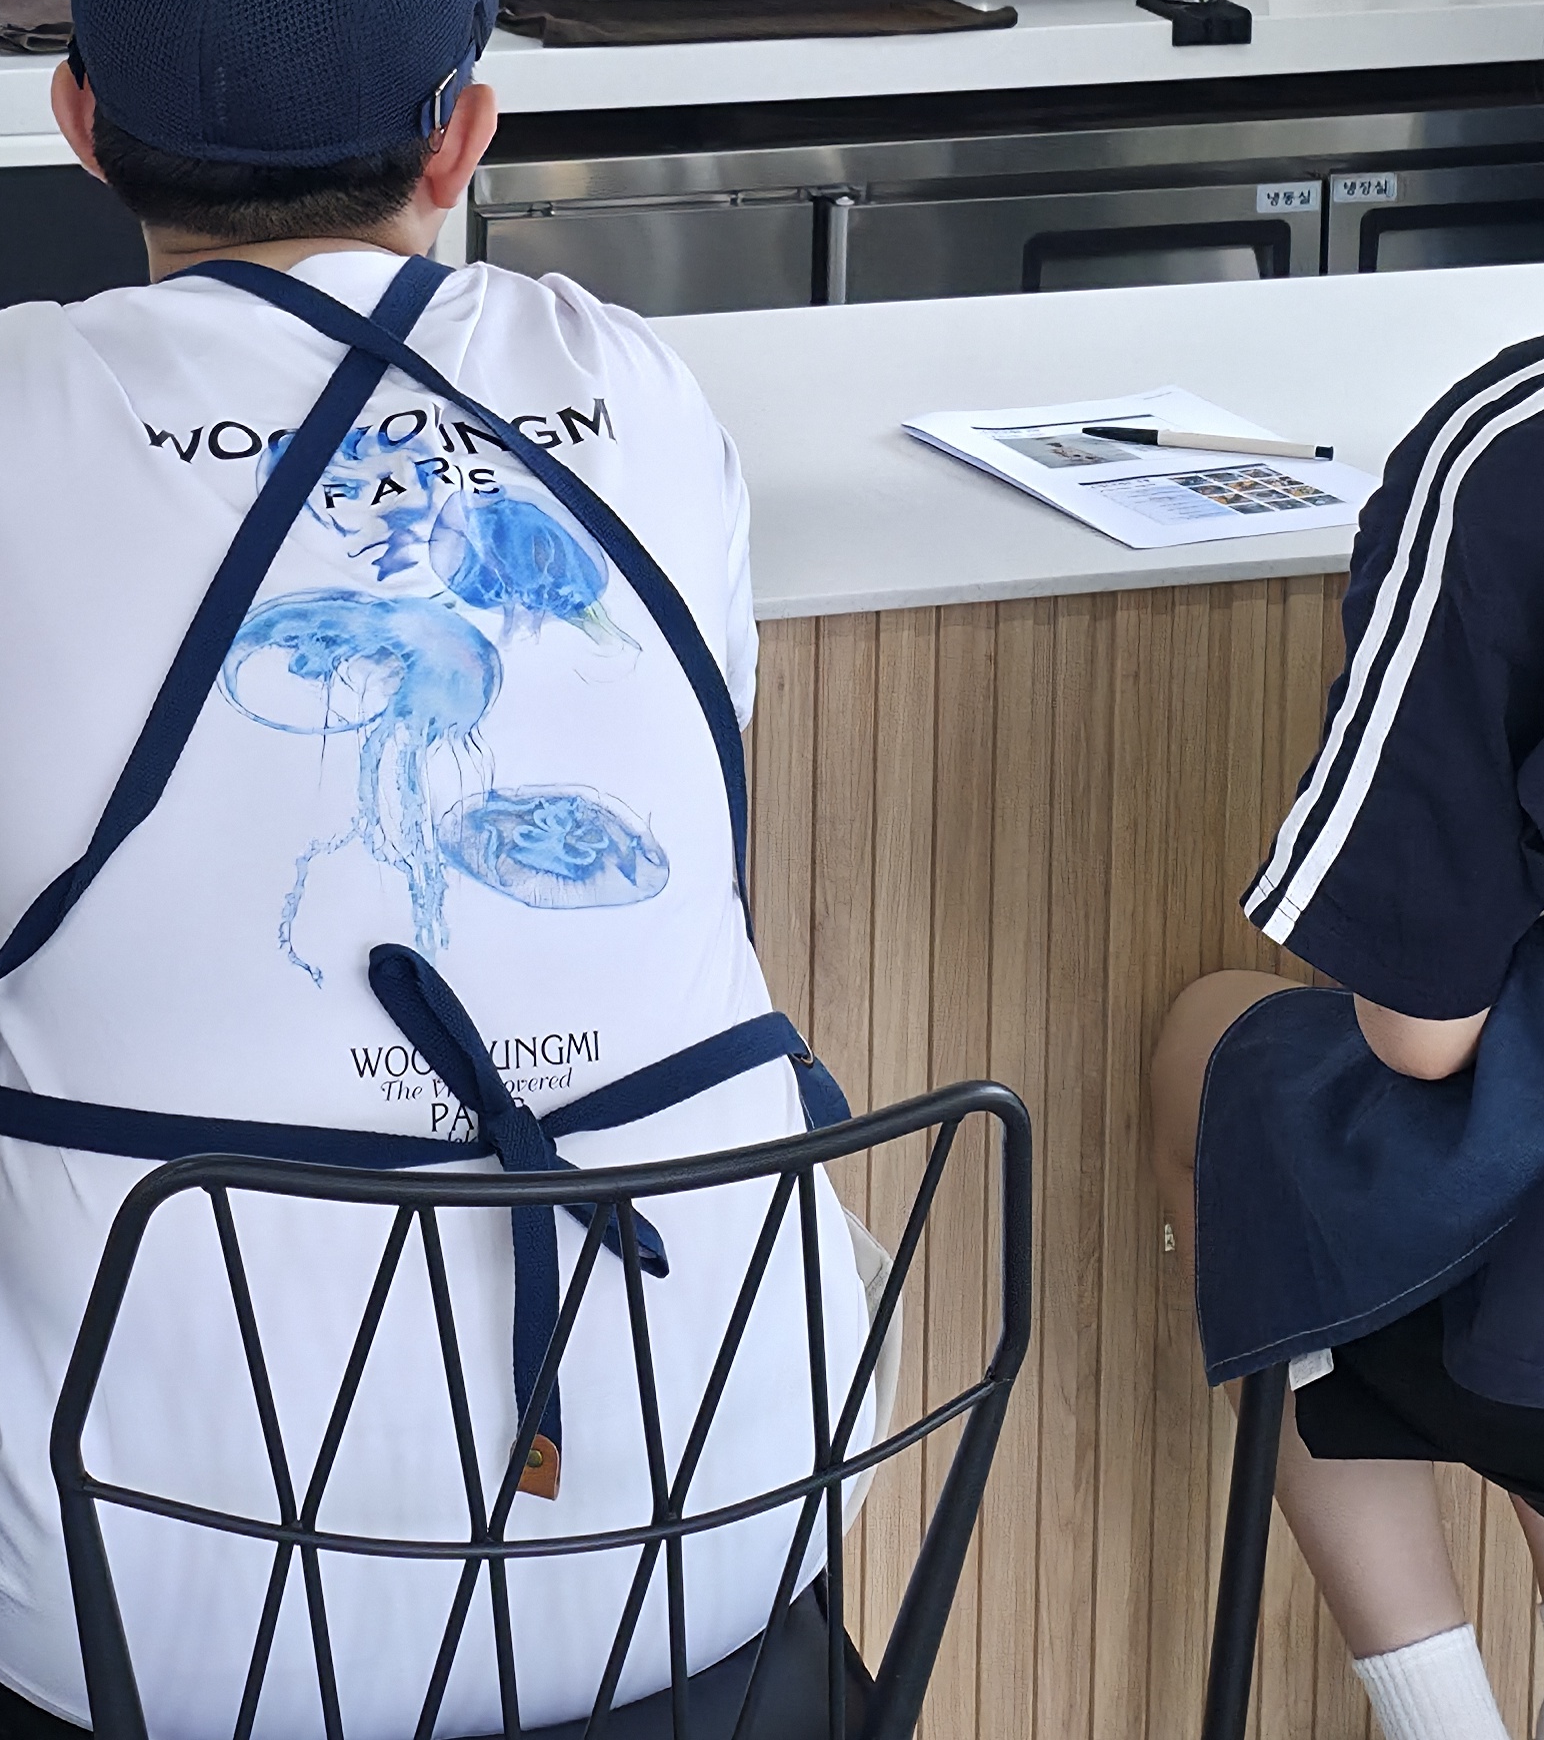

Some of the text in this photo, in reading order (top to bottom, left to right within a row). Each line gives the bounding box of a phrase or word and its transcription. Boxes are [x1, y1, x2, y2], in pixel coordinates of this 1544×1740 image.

[1343, 178, 1388, 196] 냉장실
[1266, 189, 1312, 207] 냉동실
[349, 1030, 600, 1079] WOOUNGMI
[380, 1080, 423, 1102] The
